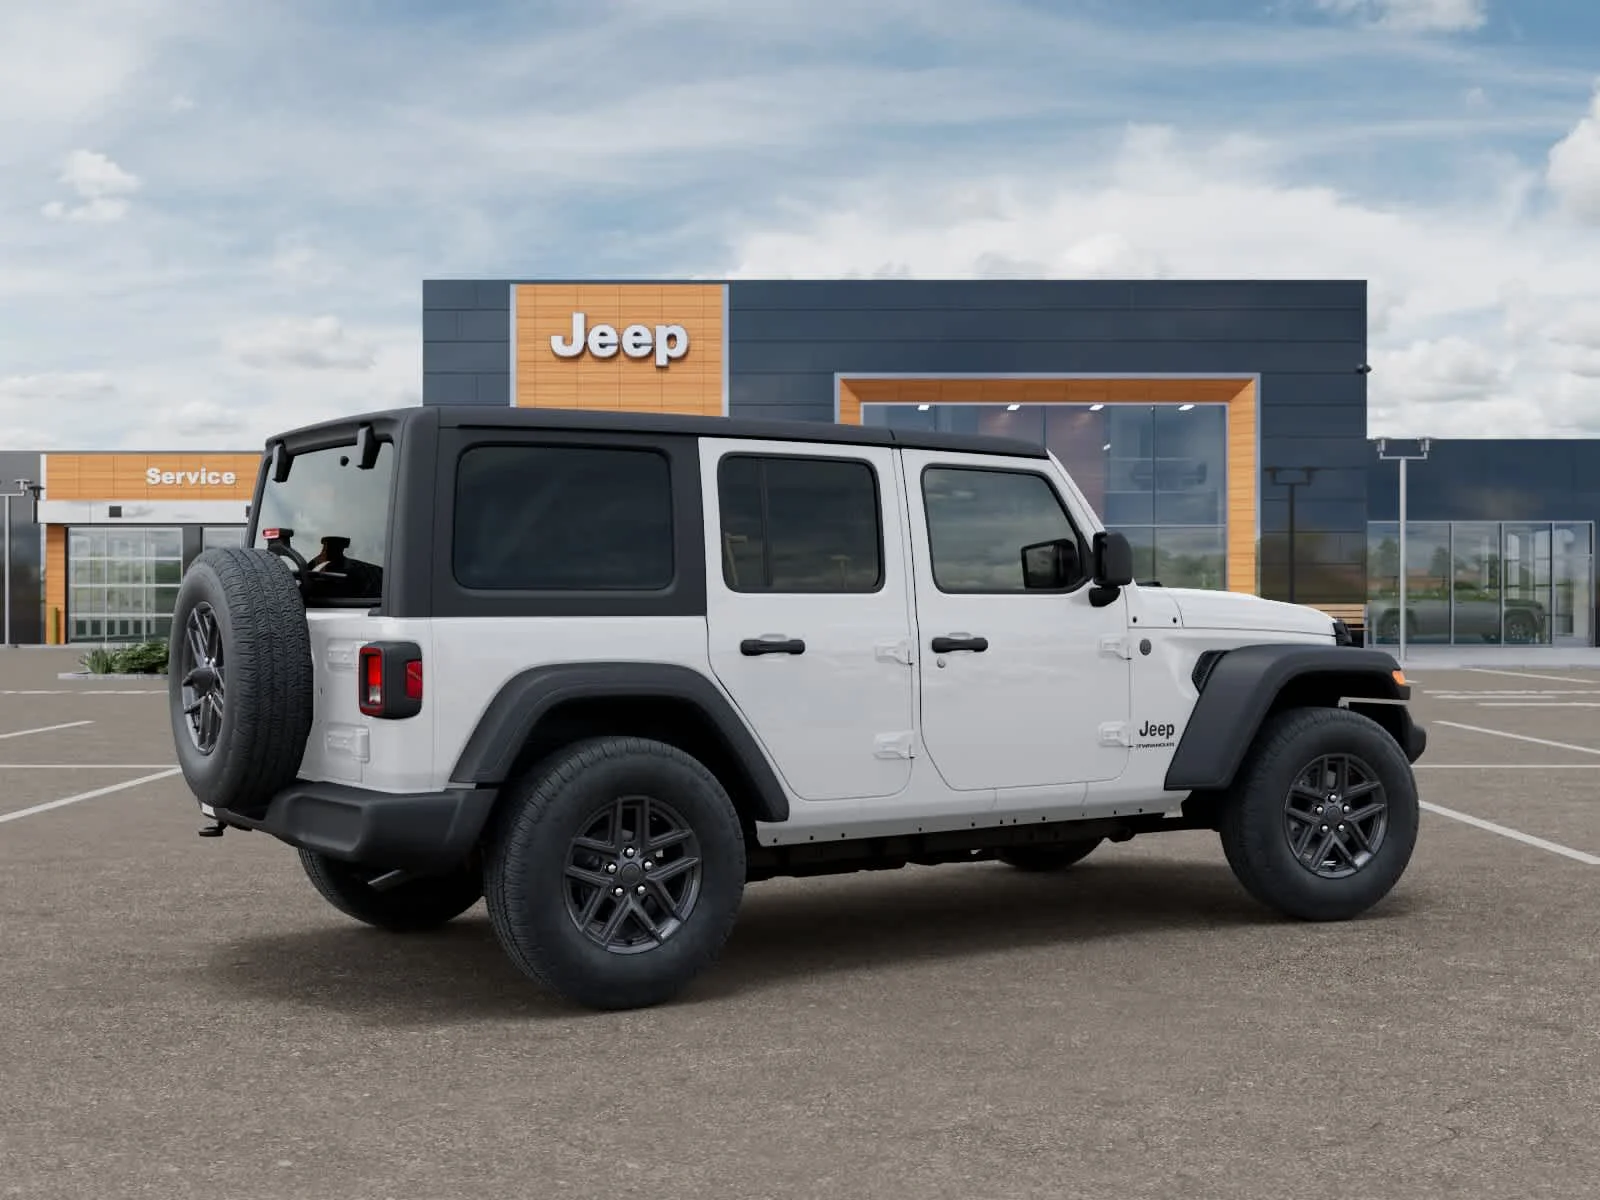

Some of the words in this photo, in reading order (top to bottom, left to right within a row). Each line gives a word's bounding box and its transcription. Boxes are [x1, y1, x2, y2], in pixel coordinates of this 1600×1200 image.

[550, 311, 689, 367] Jeep
[145, 466, 237, 486] Service
[1139, 720, 1175, 740] Jeep
